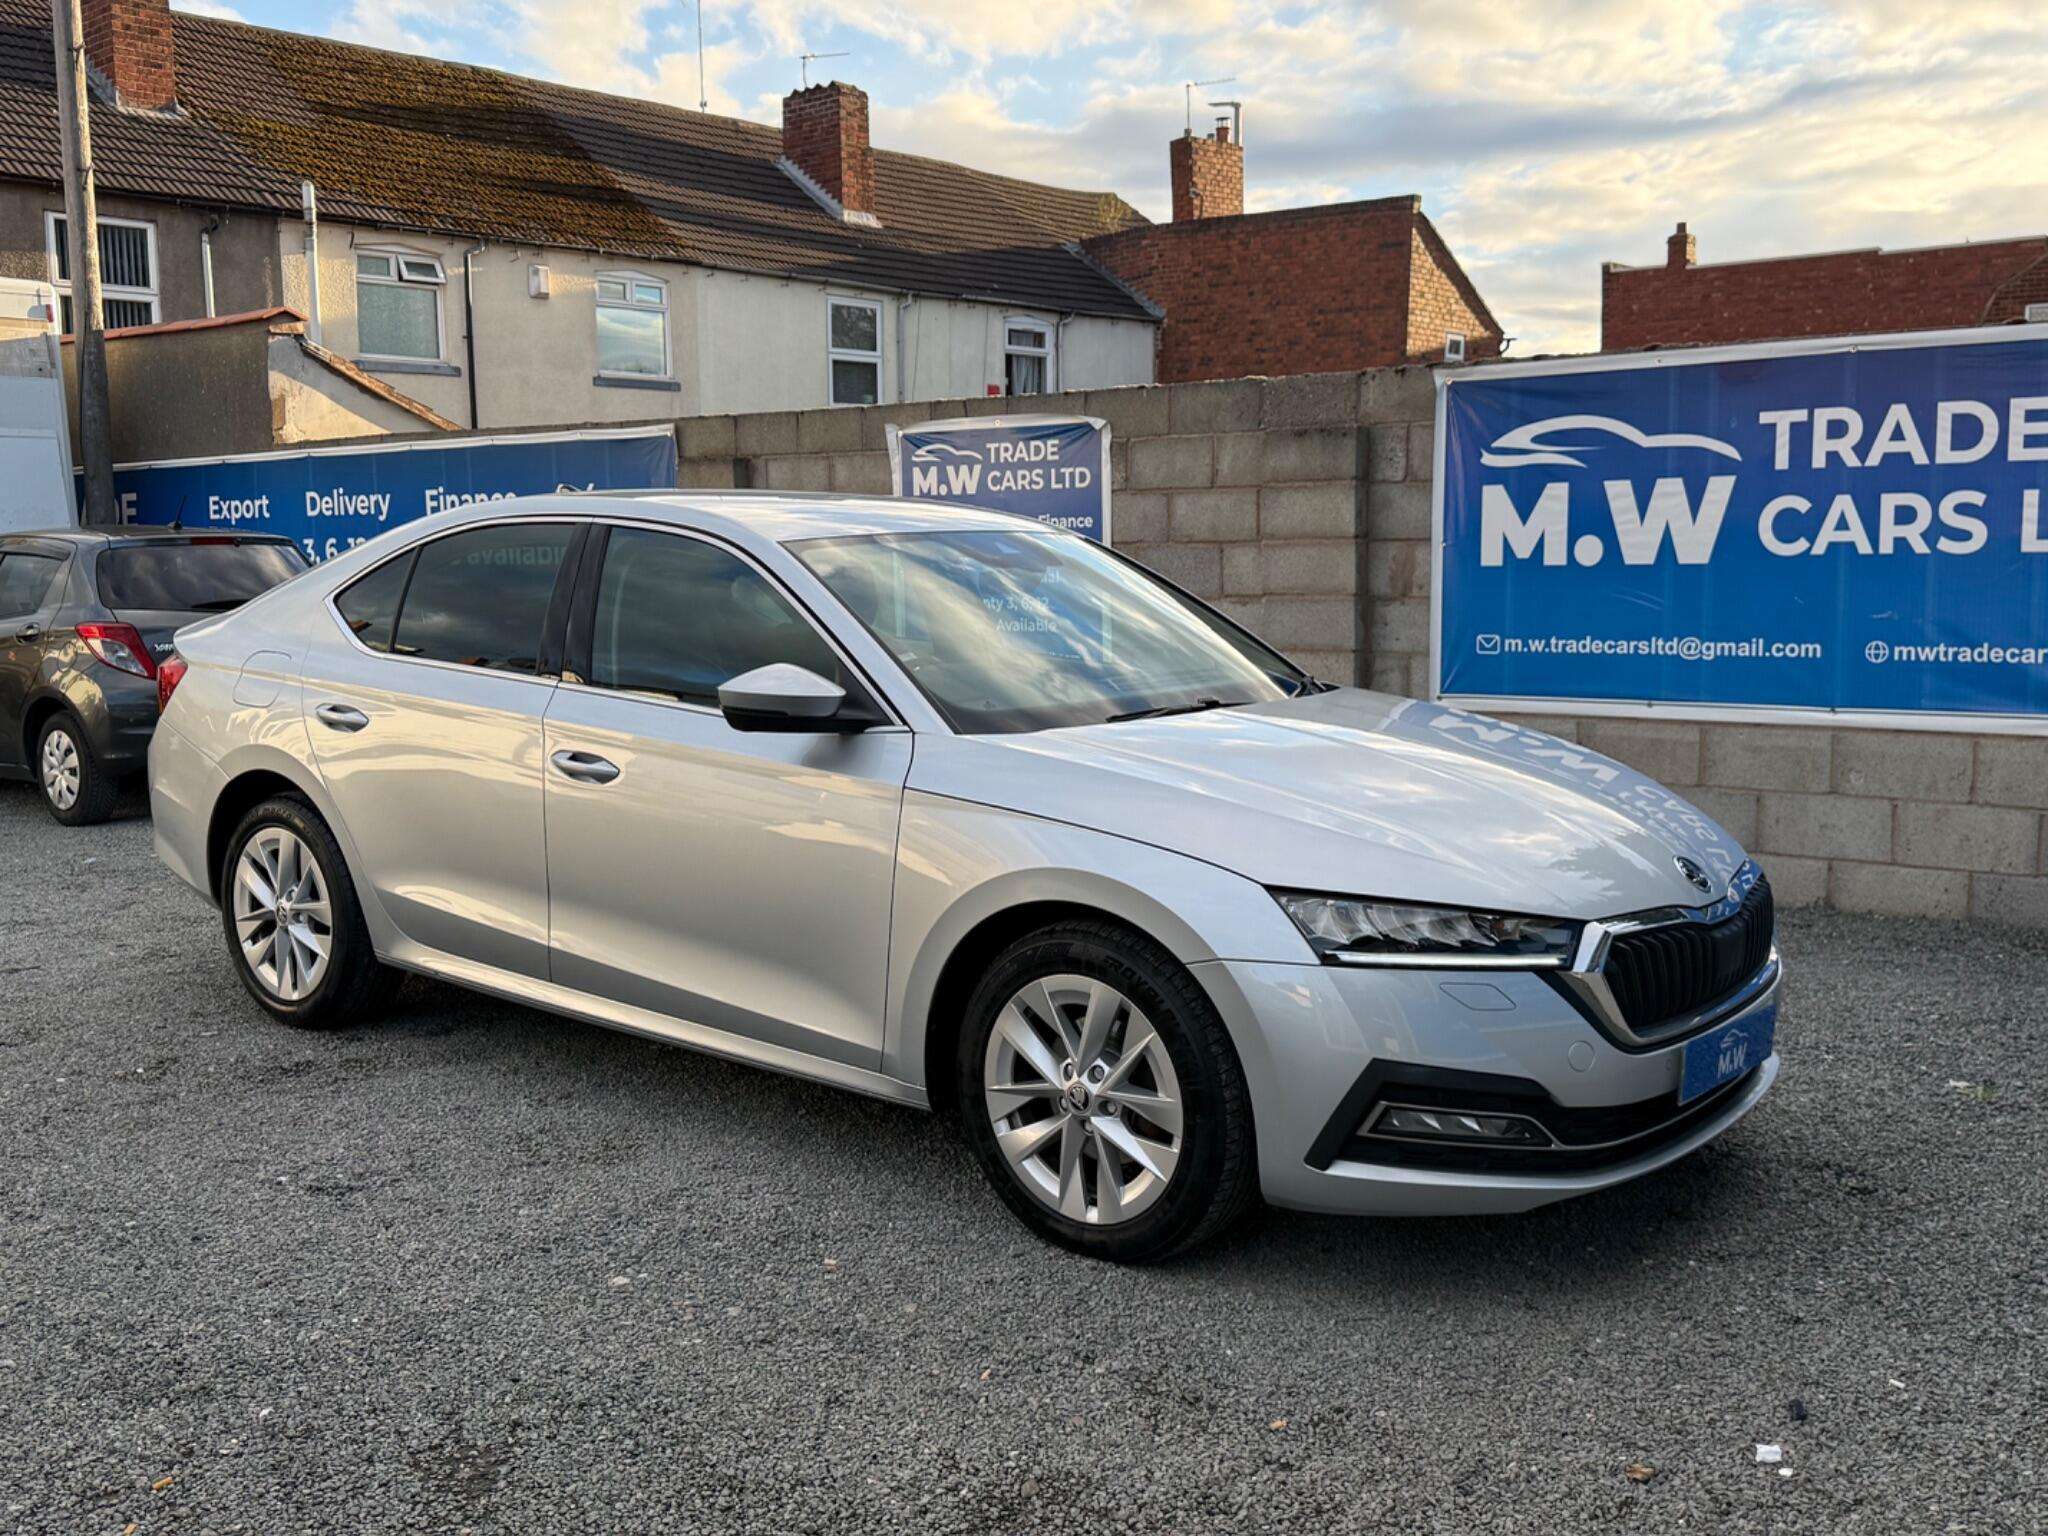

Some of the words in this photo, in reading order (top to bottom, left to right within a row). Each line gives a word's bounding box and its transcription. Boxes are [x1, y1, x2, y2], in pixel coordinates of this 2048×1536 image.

[1759, 396, 2048, 470] TRADE
[986, 440, 1059, 464] TRADE
[912, 464, 982, 497] M.W
[987, 469, 1044, 492] CARS
[1051, 467, 1091, 489] LTD
[208, 494, 270, 524] Export
[305, 487, 391, 521] Delivery
[425, 486, 517, 516] Fina
[1480, 475, 1738, 567] M.W
[1758, 489, 1988, 557] CARS
[1503, 634, 1822, 660] m.w.tradecarsltd@gmail.com
